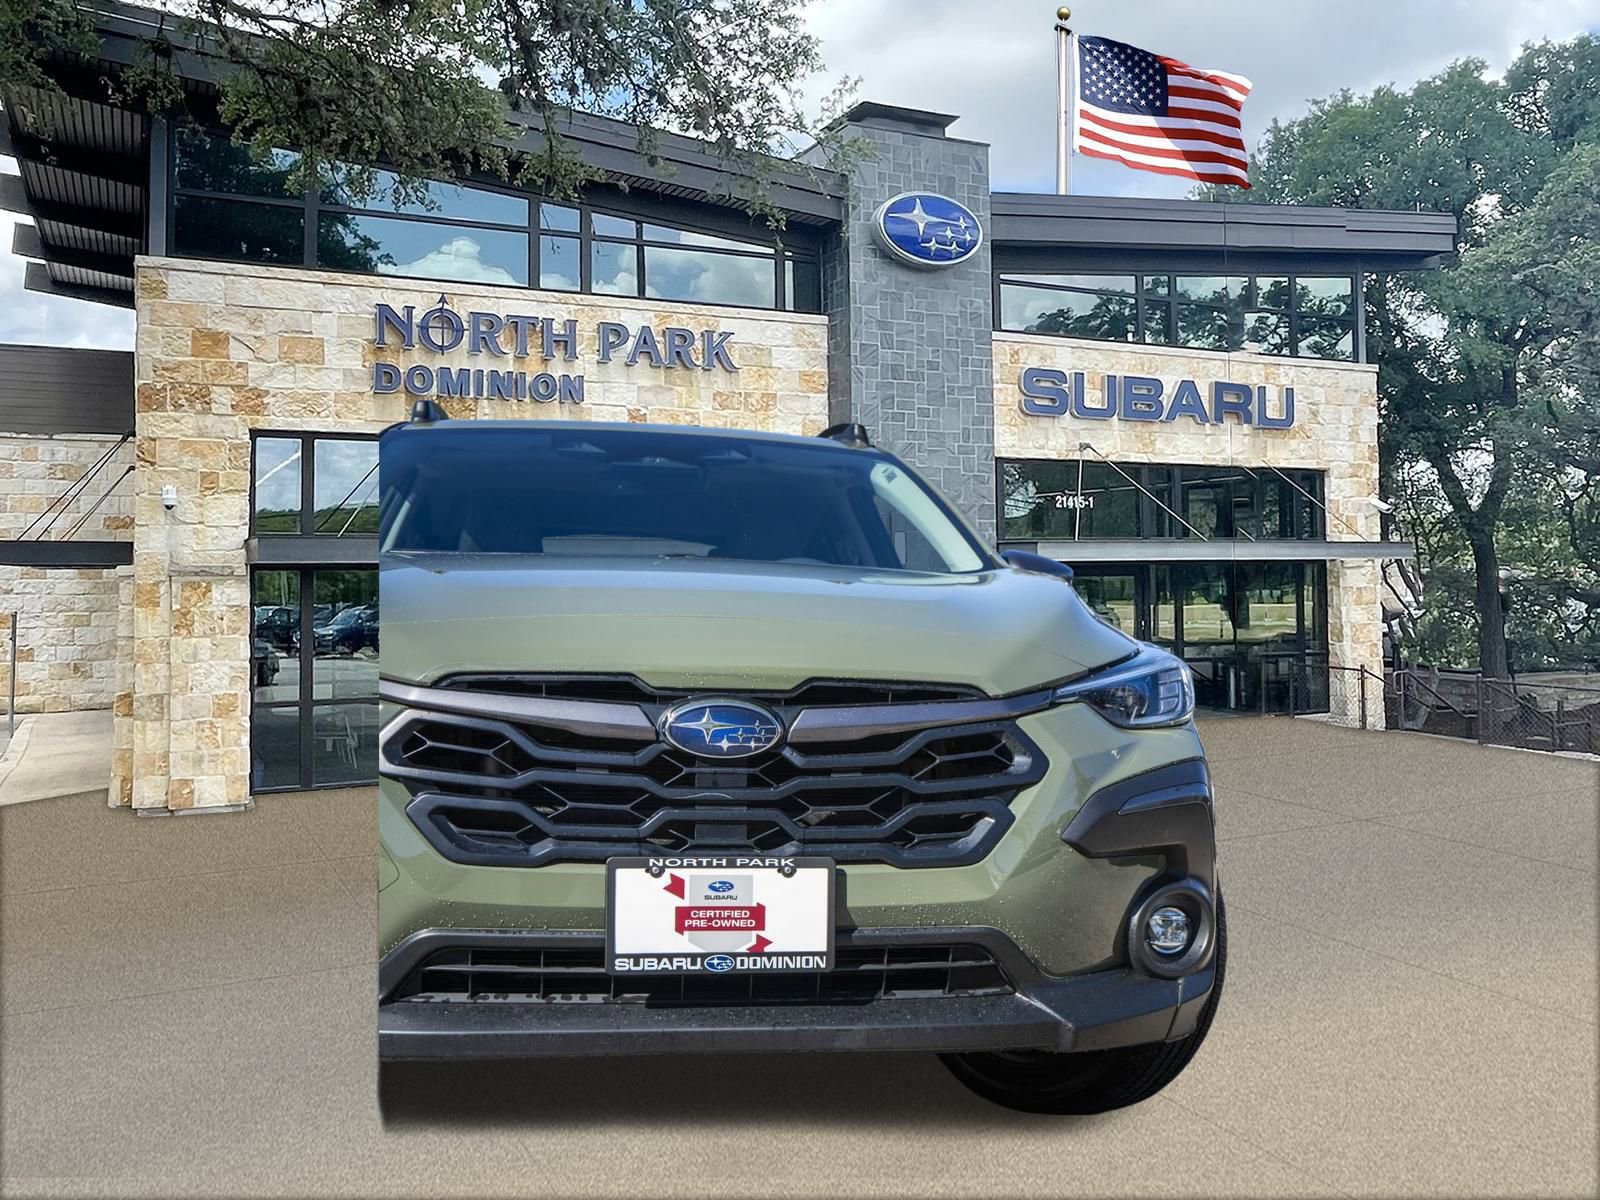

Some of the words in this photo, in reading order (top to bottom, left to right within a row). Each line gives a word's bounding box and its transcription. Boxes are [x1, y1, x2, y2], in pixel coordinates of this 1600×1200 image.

[374, 293, 579, 361] NORTH
[597, 321, 742, 372] PARK
[373, 362, 586, 404] DOMINION
[1019, 367, 1295, 430] SUBARU
[649, 858, 727, 867] NORTH
[736, 858, 796, 867] PARK
[690, 910, 750, 919] CERTIFIED
[684, 919, 756, 928] PRE-OWNED
[614, 957, 702, 971] SUBARU
[735, 955, 826, 969] DOMINION
